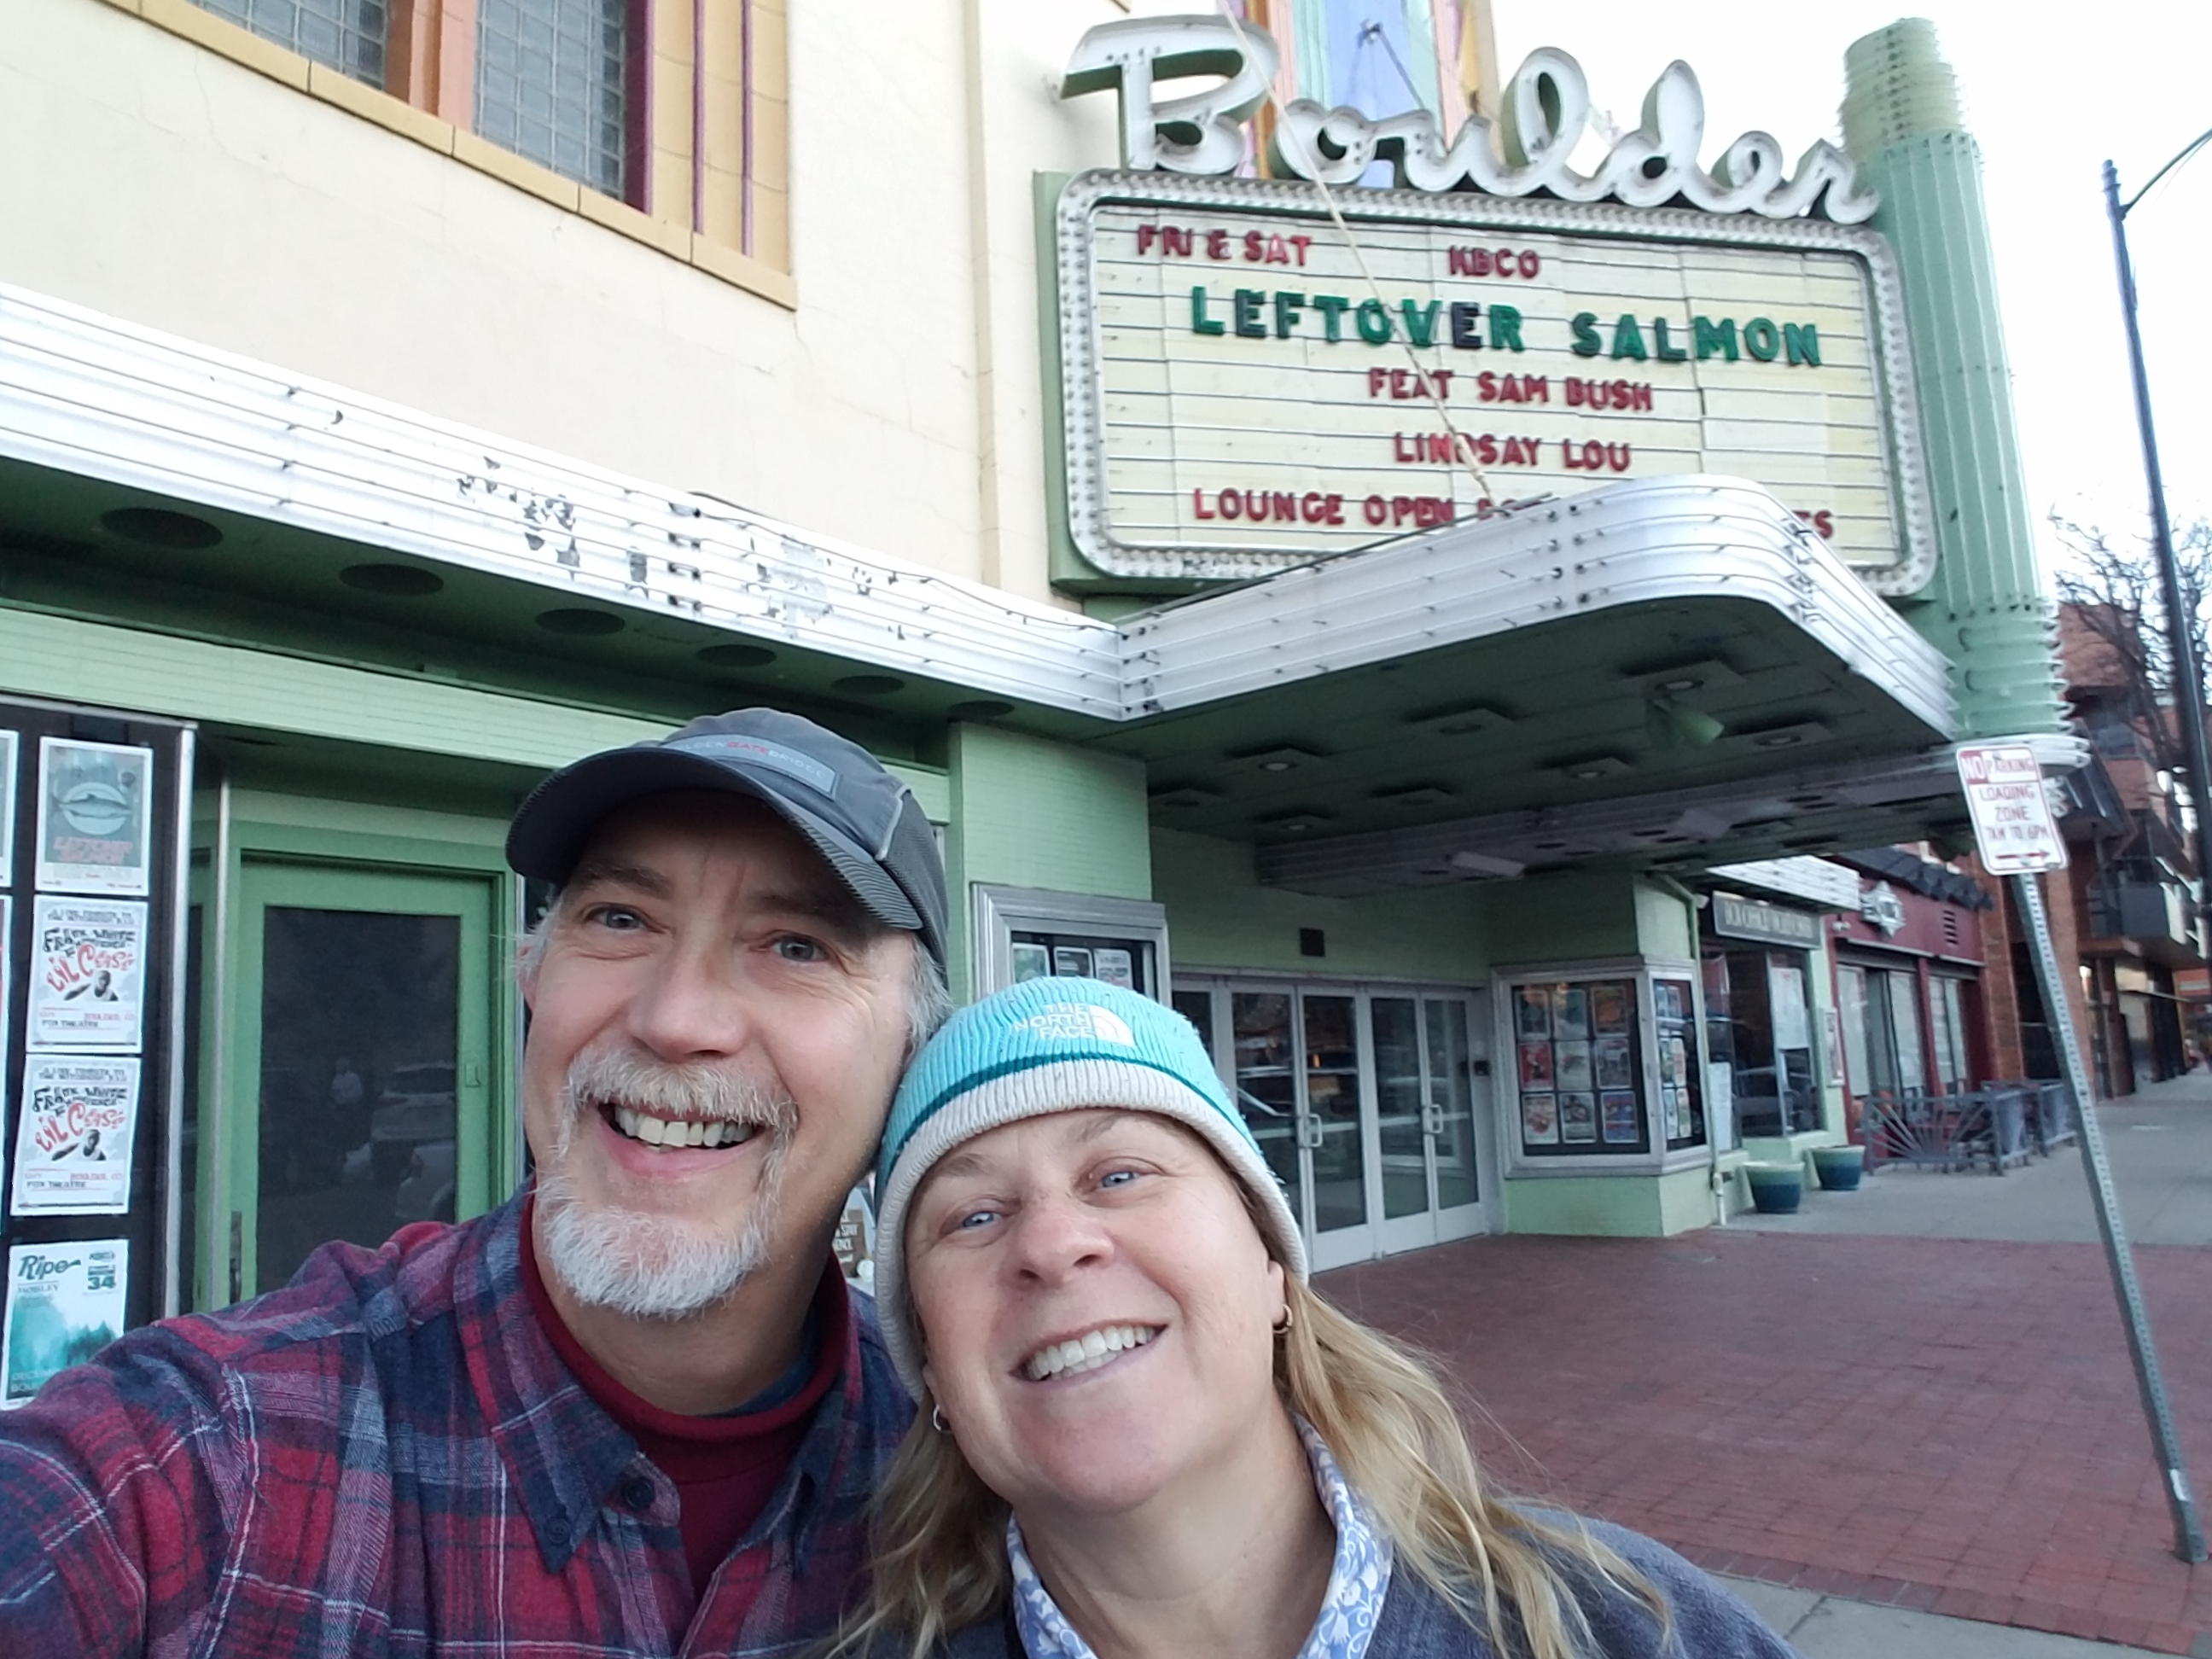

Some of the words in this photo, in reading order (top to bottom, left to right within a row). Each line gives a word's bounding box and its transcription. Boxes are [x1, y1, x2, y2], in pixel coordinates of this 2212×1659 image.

[1061, 15, 1882, 224] Boulder
[1137, 224, 1192, 256] FRI
[1244, 230, 1312, 266] SAT
[1448, 245, 1540, 279] KBCO
[1192, 286, 1525, 352] LEFTOVER
[1572, 312, 1821, 367] SALMON
[1369, 367, 1453, 399] FEAT
[1477, 370, 1549, 403] SAM
[1565, 377, 1653, 411] BUSH
[1394, 432, 1541, 466] LINDSAY
[1563, 439, 1631, 472] LOU
[1195, 487, 1345, 525] LOUNGE
[1364, 495, 1455, 527] OPEN
[1961, 755, 1987, 780] NO
[1986, 758, 2036, 774] PARKING
[1980, 785, 2035, 801] LOADING
[1995, 806, 2032, 822] ZONE
[1013, 1013, 1091, 1032] NORTH
[1045, 1002, 1091, 1015] THE
[1039, 1026, 1097, 1040] FACE
[18, 1254, 81, 1280] Ripe
